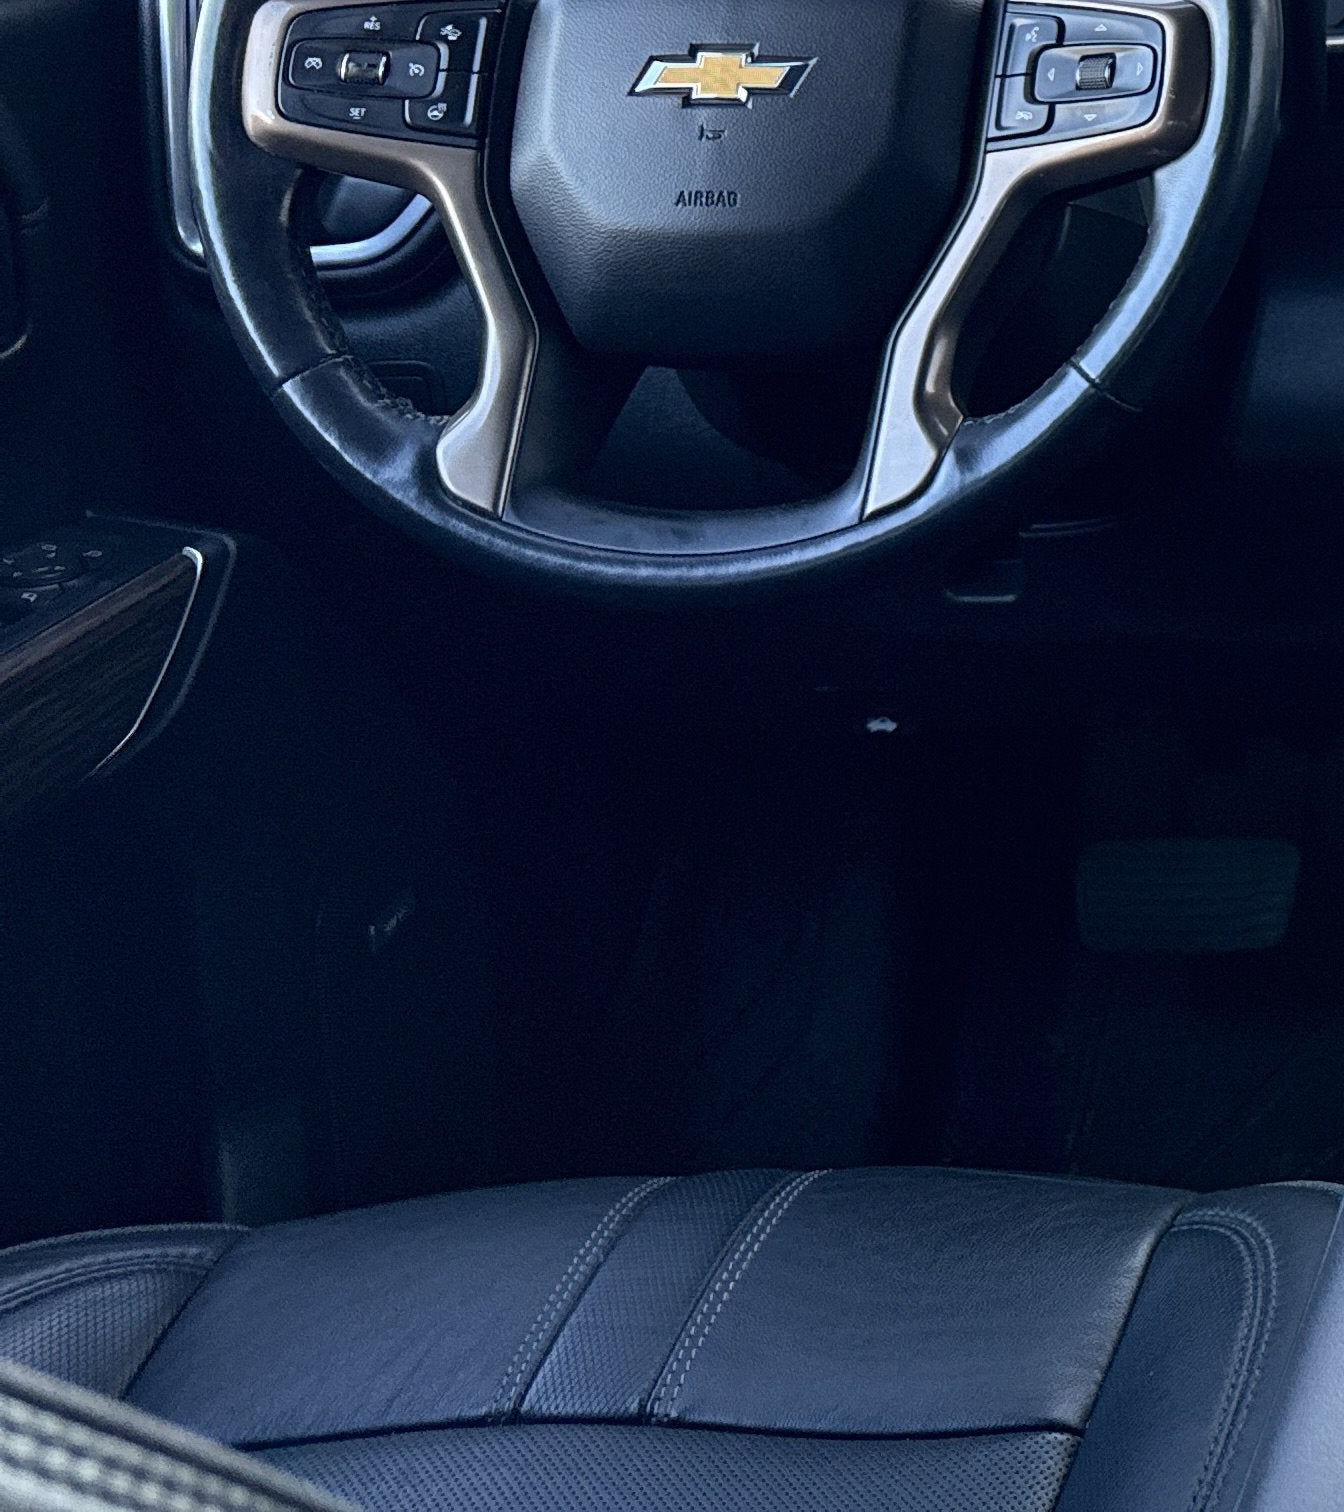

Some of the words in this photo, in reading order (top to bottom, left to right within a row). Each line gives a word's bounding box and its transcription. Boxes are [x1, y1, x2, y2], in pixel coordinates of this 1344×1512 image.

[363, 20, 381, 31] RES
[349, 107, 367, 118] SET
[675, 191, 739, 208] AIRBAG
